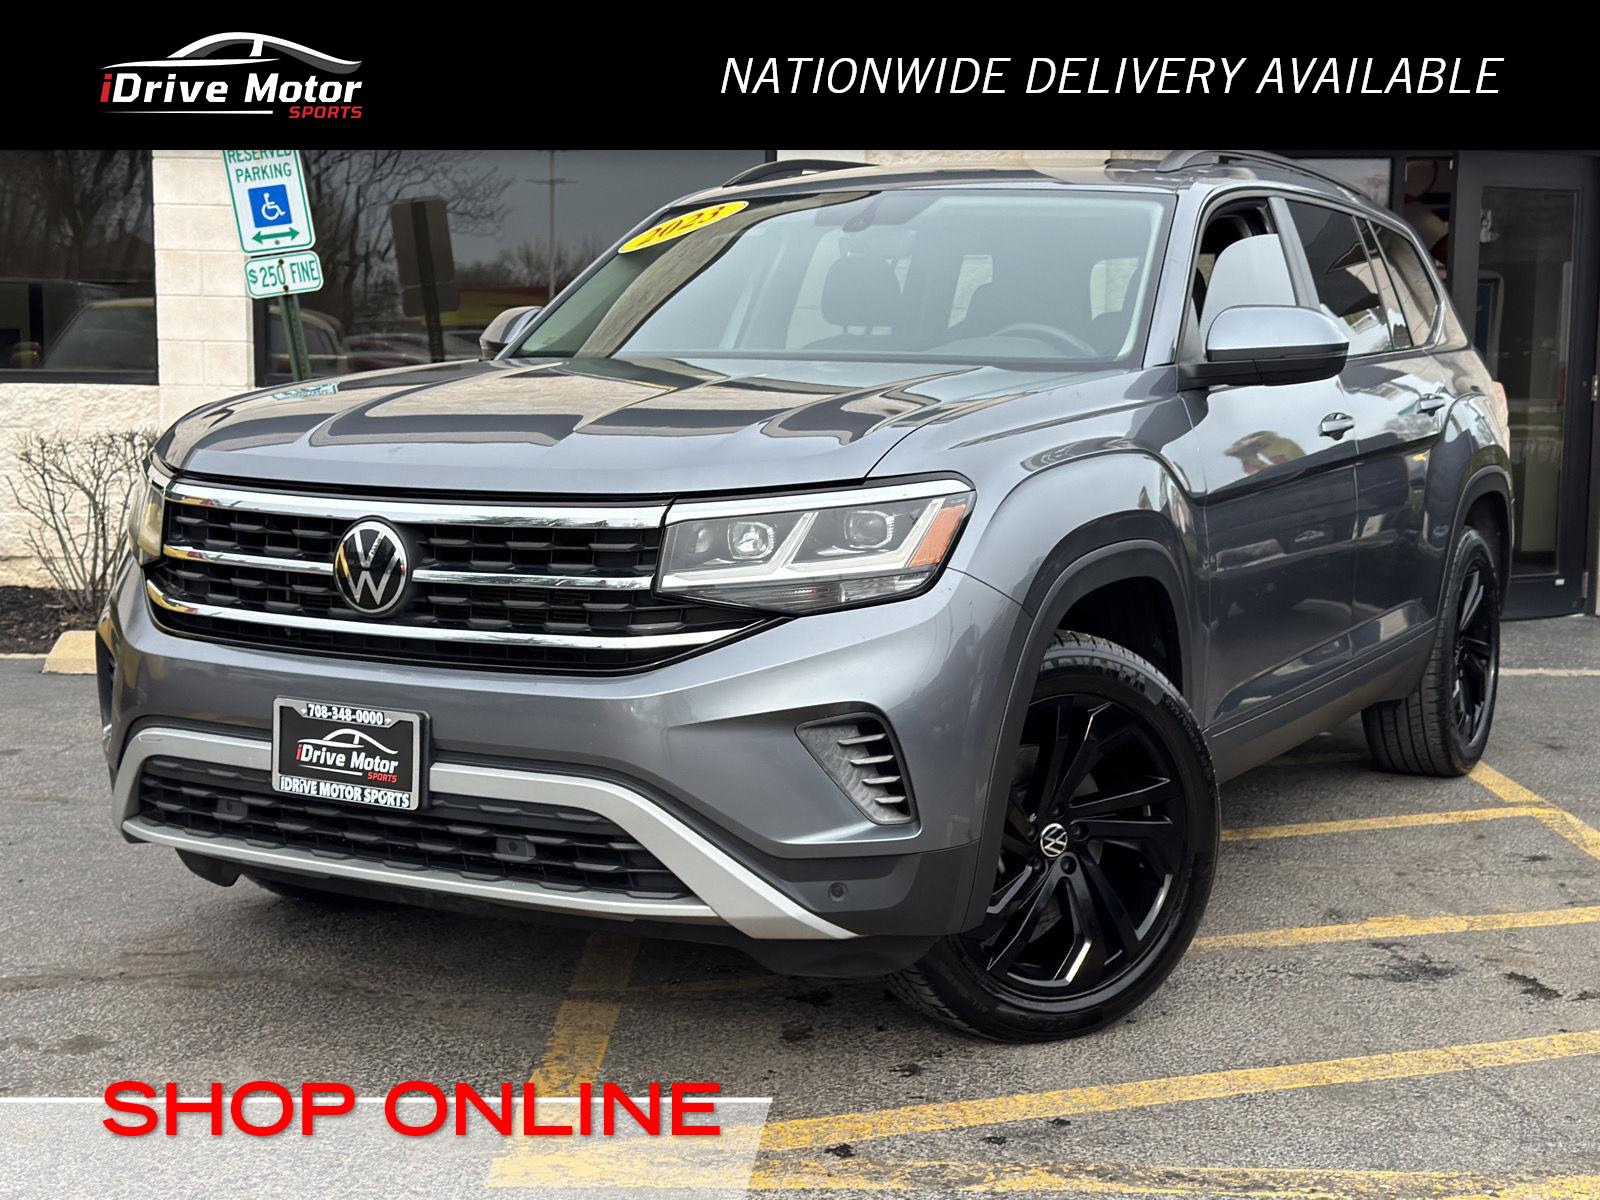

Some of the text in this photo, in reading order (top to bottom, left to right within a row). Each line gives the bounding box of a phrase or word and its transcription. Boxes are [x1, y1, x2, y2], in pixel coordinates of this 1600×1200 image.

[235, 162, 292, 184] PARKING
[635, 205, 726, 248] 2023
[249, 260, 319, 288] $250 FINE
[308, 703, 383, 725] 708-348-0000
[296, 743, 399, 774] iDrive Motor
[367, 771, 398, 783] SPORTS
[319, 782, 362, 802] MOTOR
[364, 788, 410, 808] SPORTS
